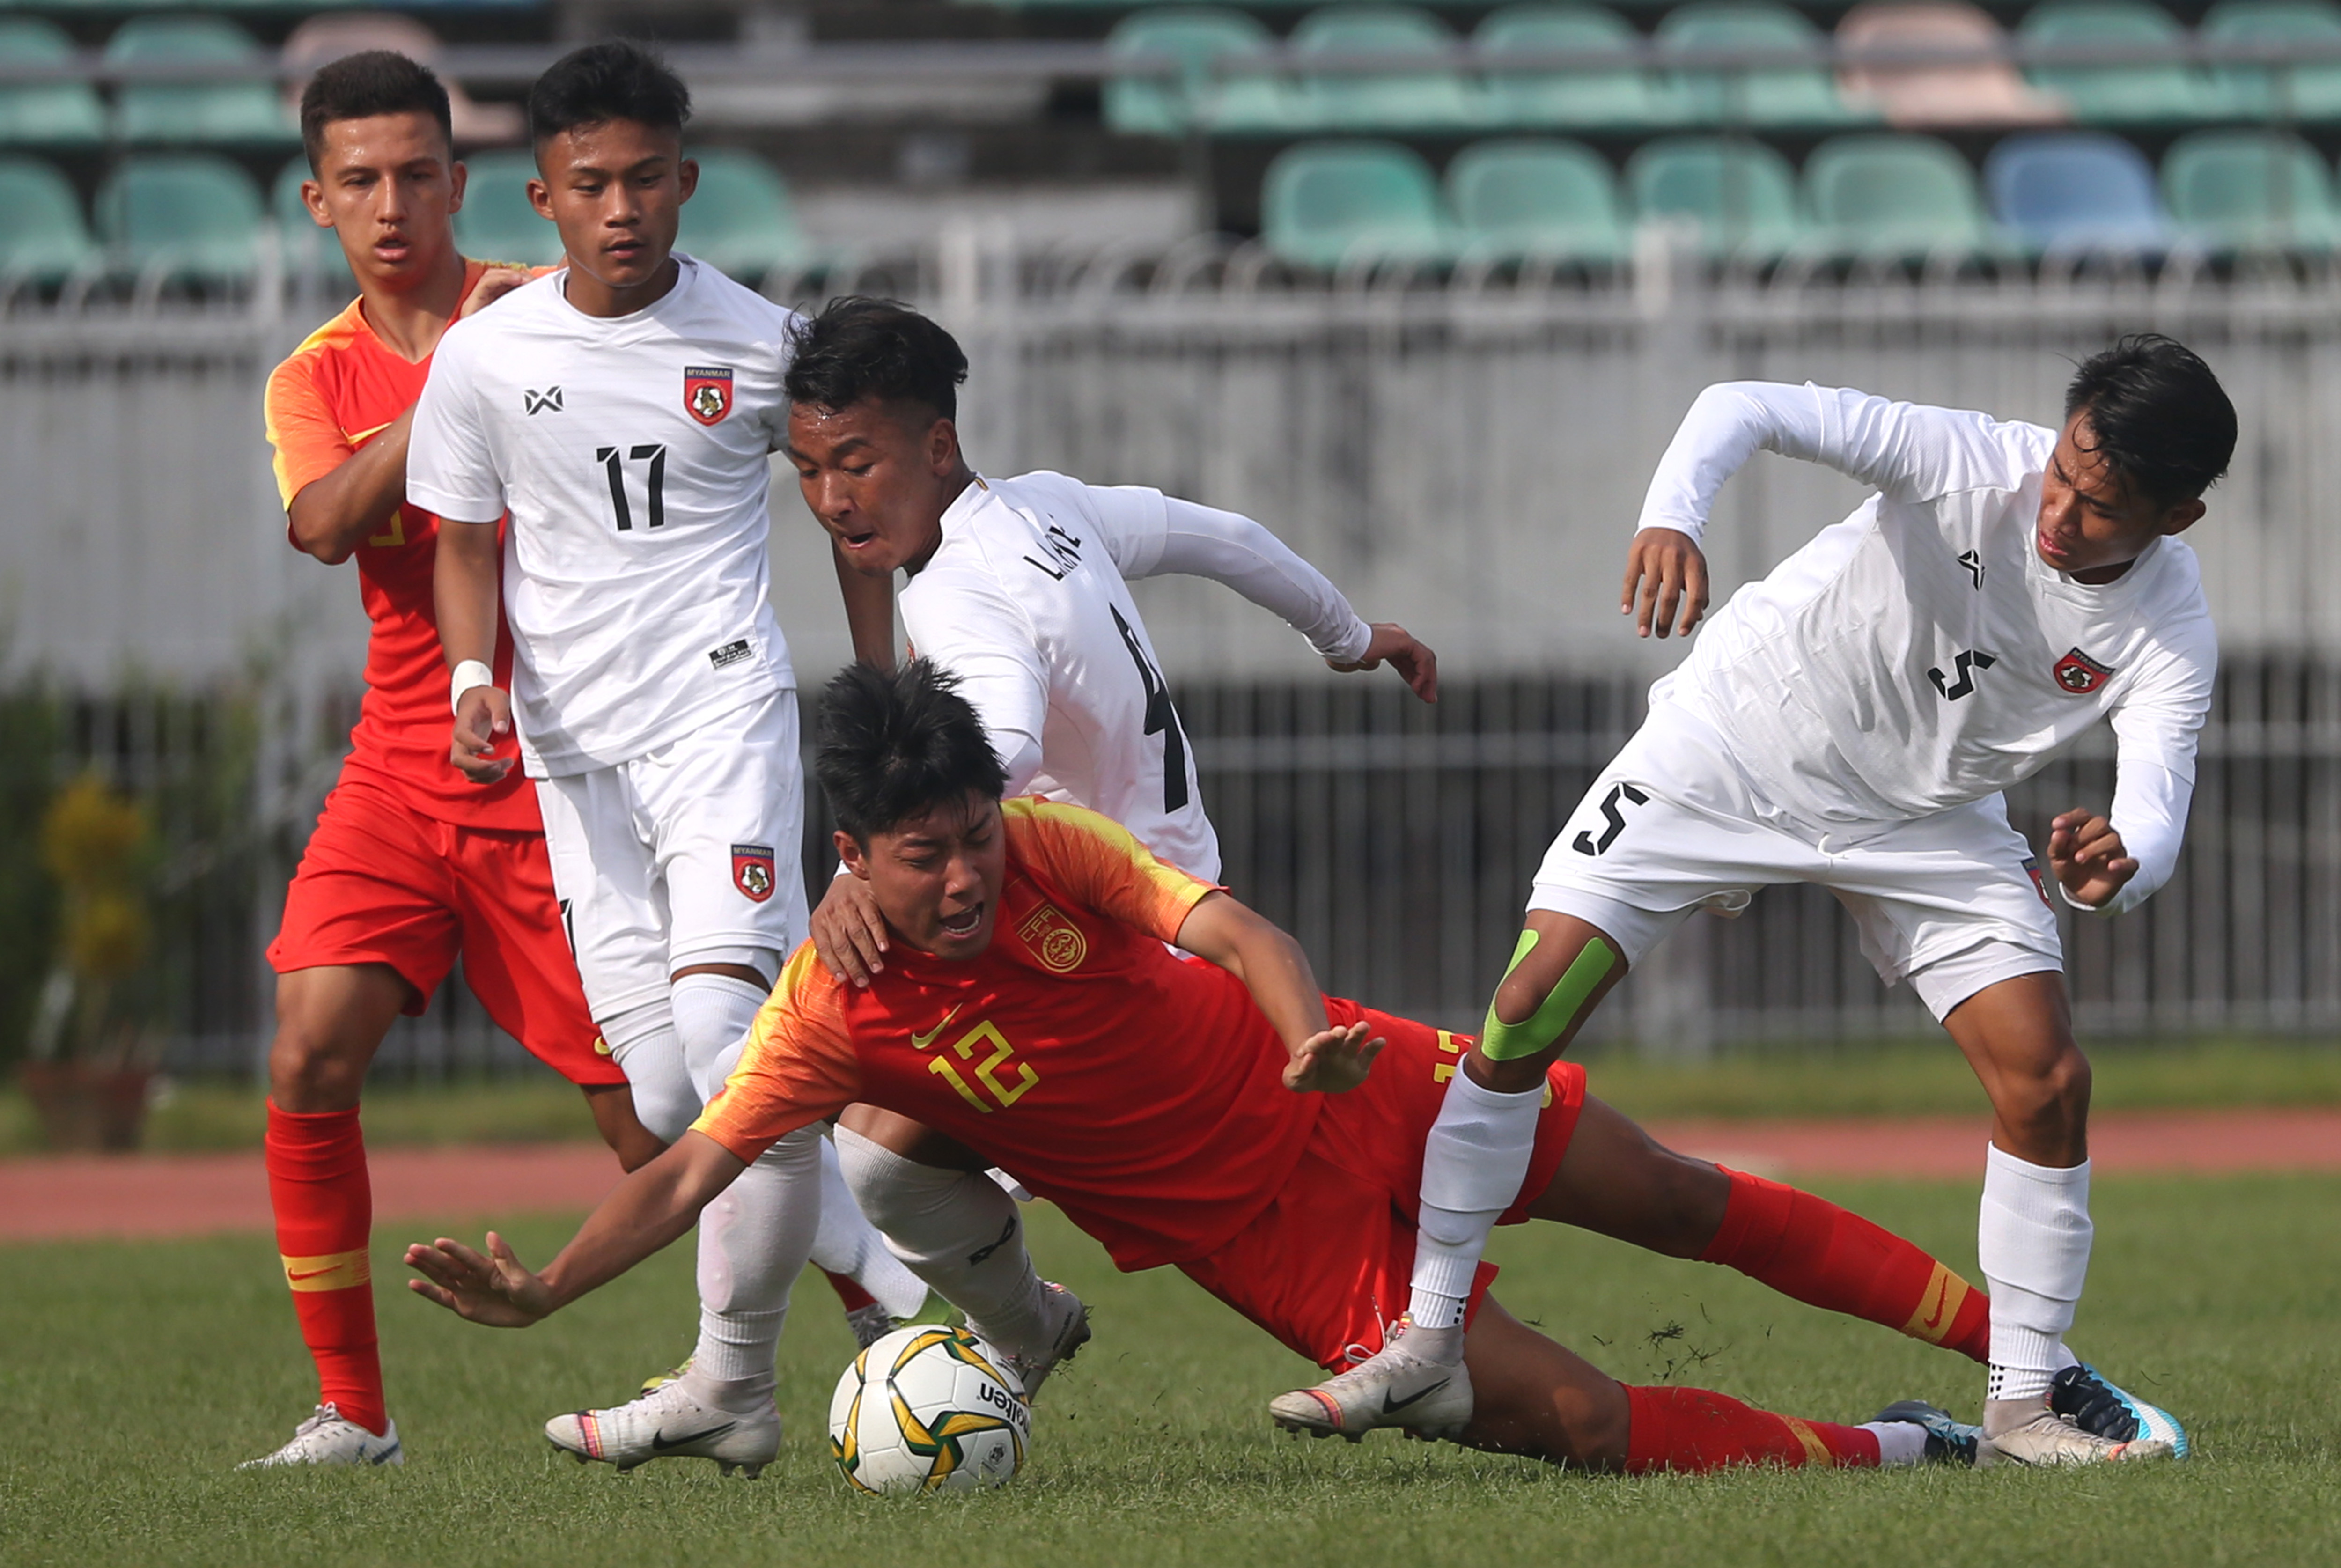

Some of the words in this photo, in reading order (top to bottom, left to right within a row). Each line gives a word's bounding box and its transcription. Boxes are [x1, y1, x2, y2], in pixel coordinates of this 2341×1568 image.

[686, 368, 731, 378] MYANMAR
[596, 443, 667, 531] 17
[1109, 602, 1189, 814] 4
[1927, 648, 1997, 702] 5
[1571, 781, 1650, 857] 5
[1021, 909, 1055, 942] CFA
[927, 1019, 1040, 1114] 12
